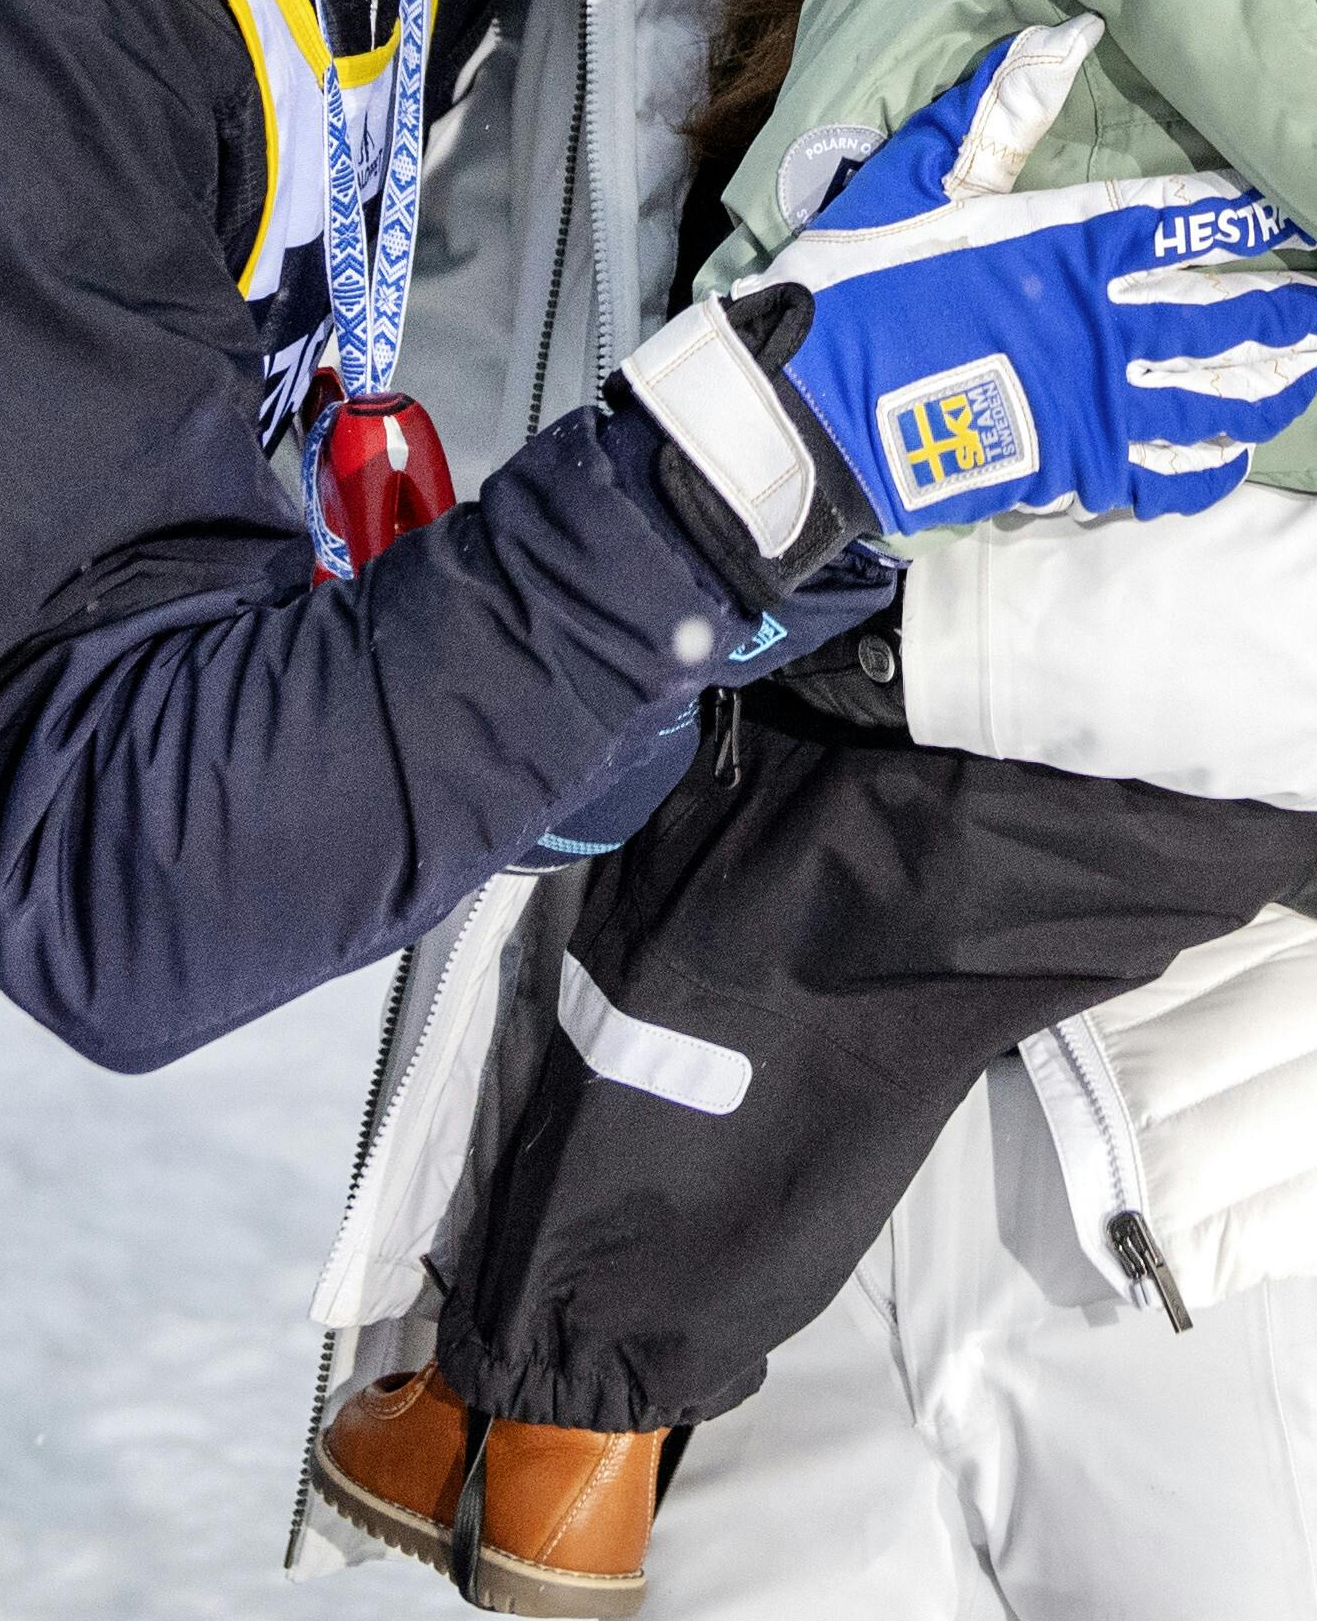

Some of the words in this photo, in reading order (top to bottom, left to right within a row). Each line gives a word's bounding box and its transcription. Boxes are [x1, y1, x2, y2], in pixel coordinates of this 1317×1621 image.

[804, 137, 860, 161] POLARN
[939, 394, 985, 471] SKI
[967, 386, 1003, 462] TEAM
[985, 382, 1016, 457] SWEDEN
